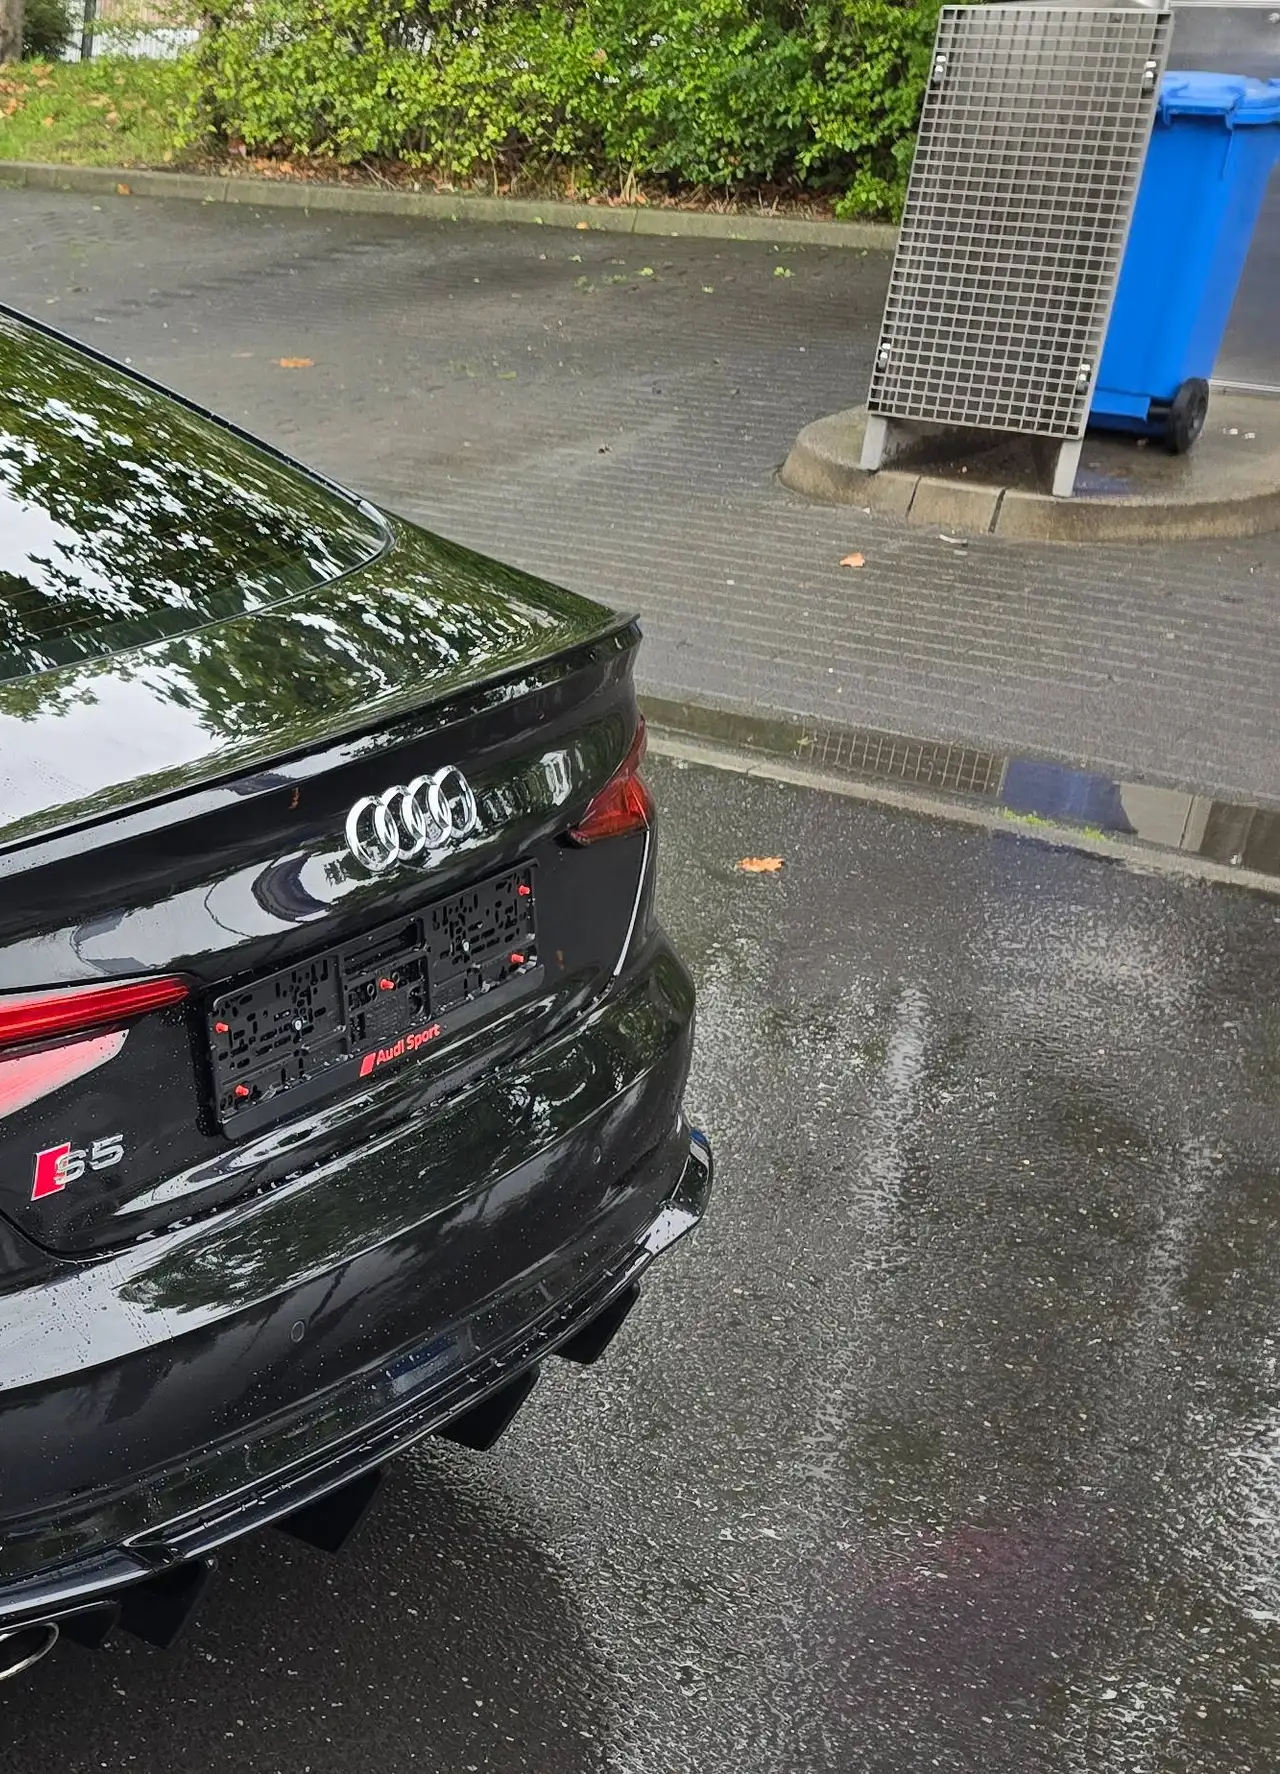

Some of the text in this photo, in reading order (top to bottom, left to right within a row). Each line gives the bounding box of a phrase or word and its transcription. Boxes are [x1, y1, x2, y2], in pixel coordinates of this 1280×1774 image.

[376, 1023, 441, 1066] Audi Sport
[52, 1134, 125, 1186] S5
